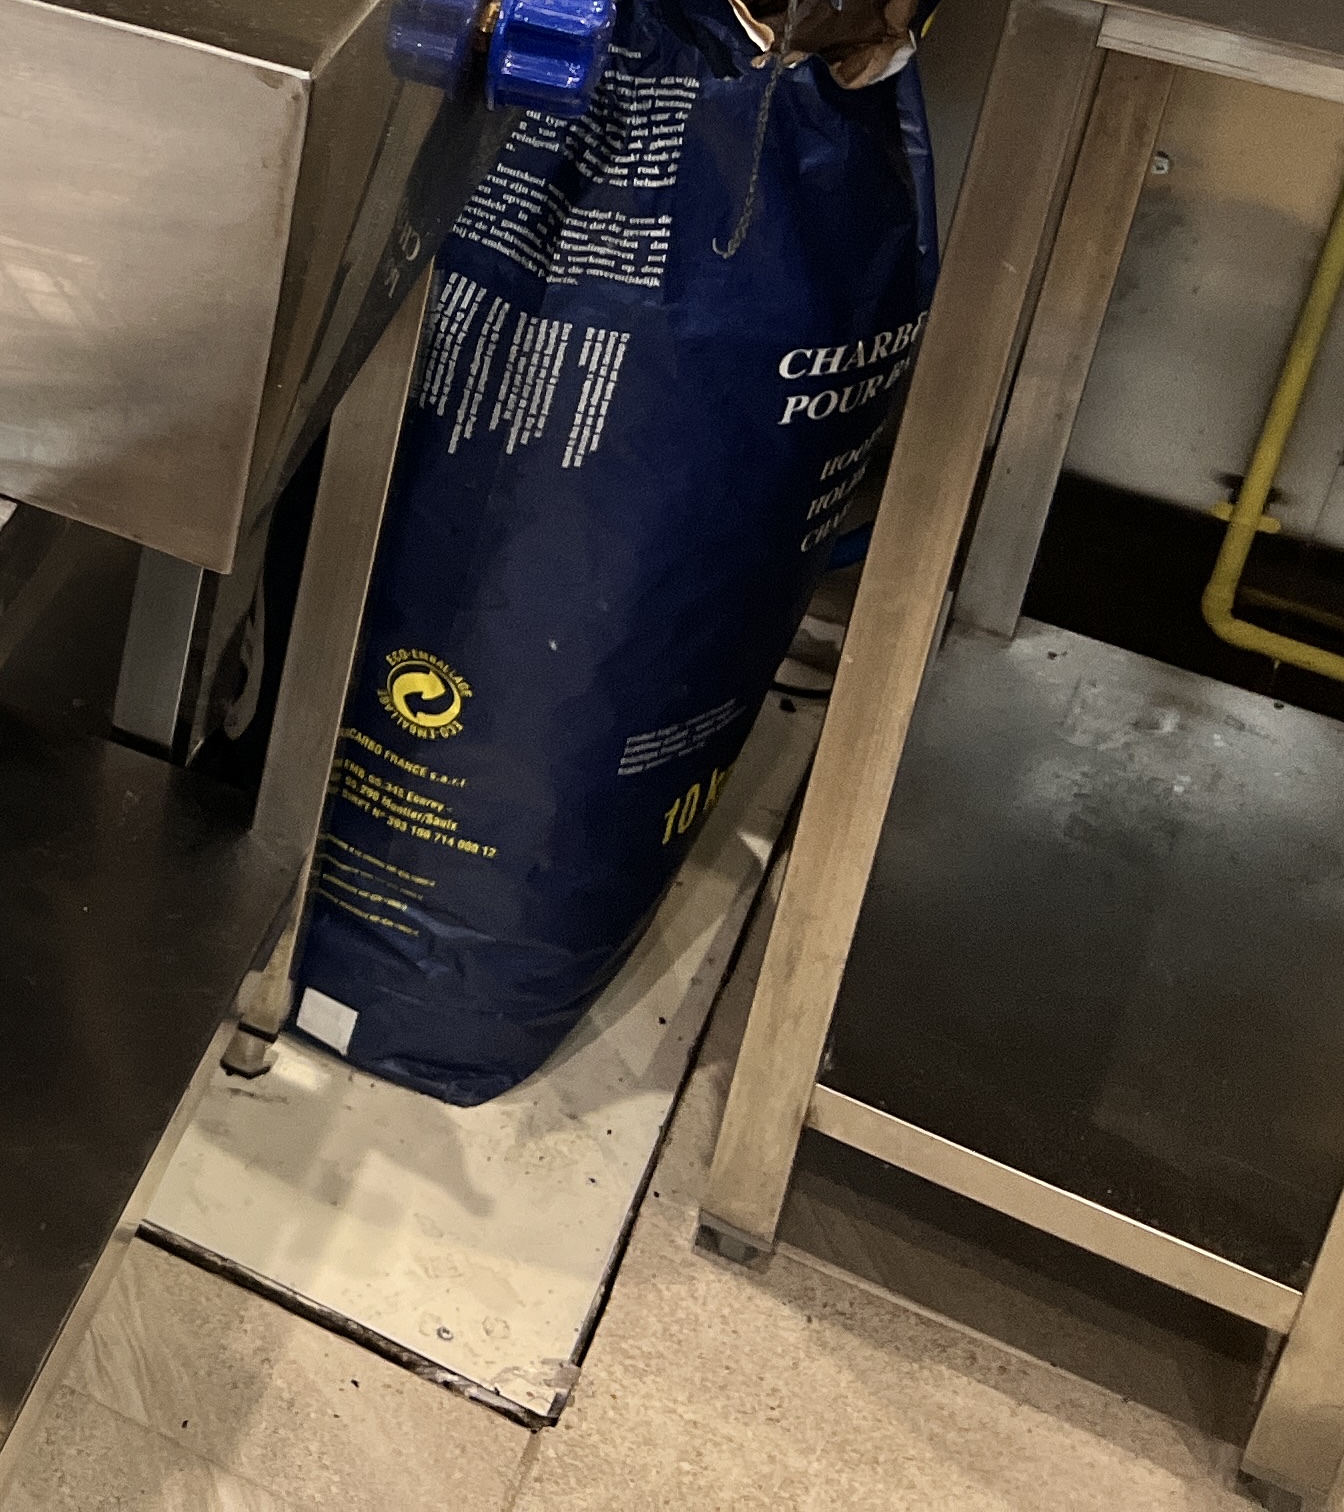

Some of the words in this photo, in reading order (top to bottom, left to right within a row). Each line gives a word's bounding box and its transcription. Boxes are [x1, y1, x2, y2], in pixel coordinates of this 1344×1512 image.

[776, 374, 885, 425] POUR
[384, 749, 429, 778] FRANCE
[662, 783, 700, 845] 10
